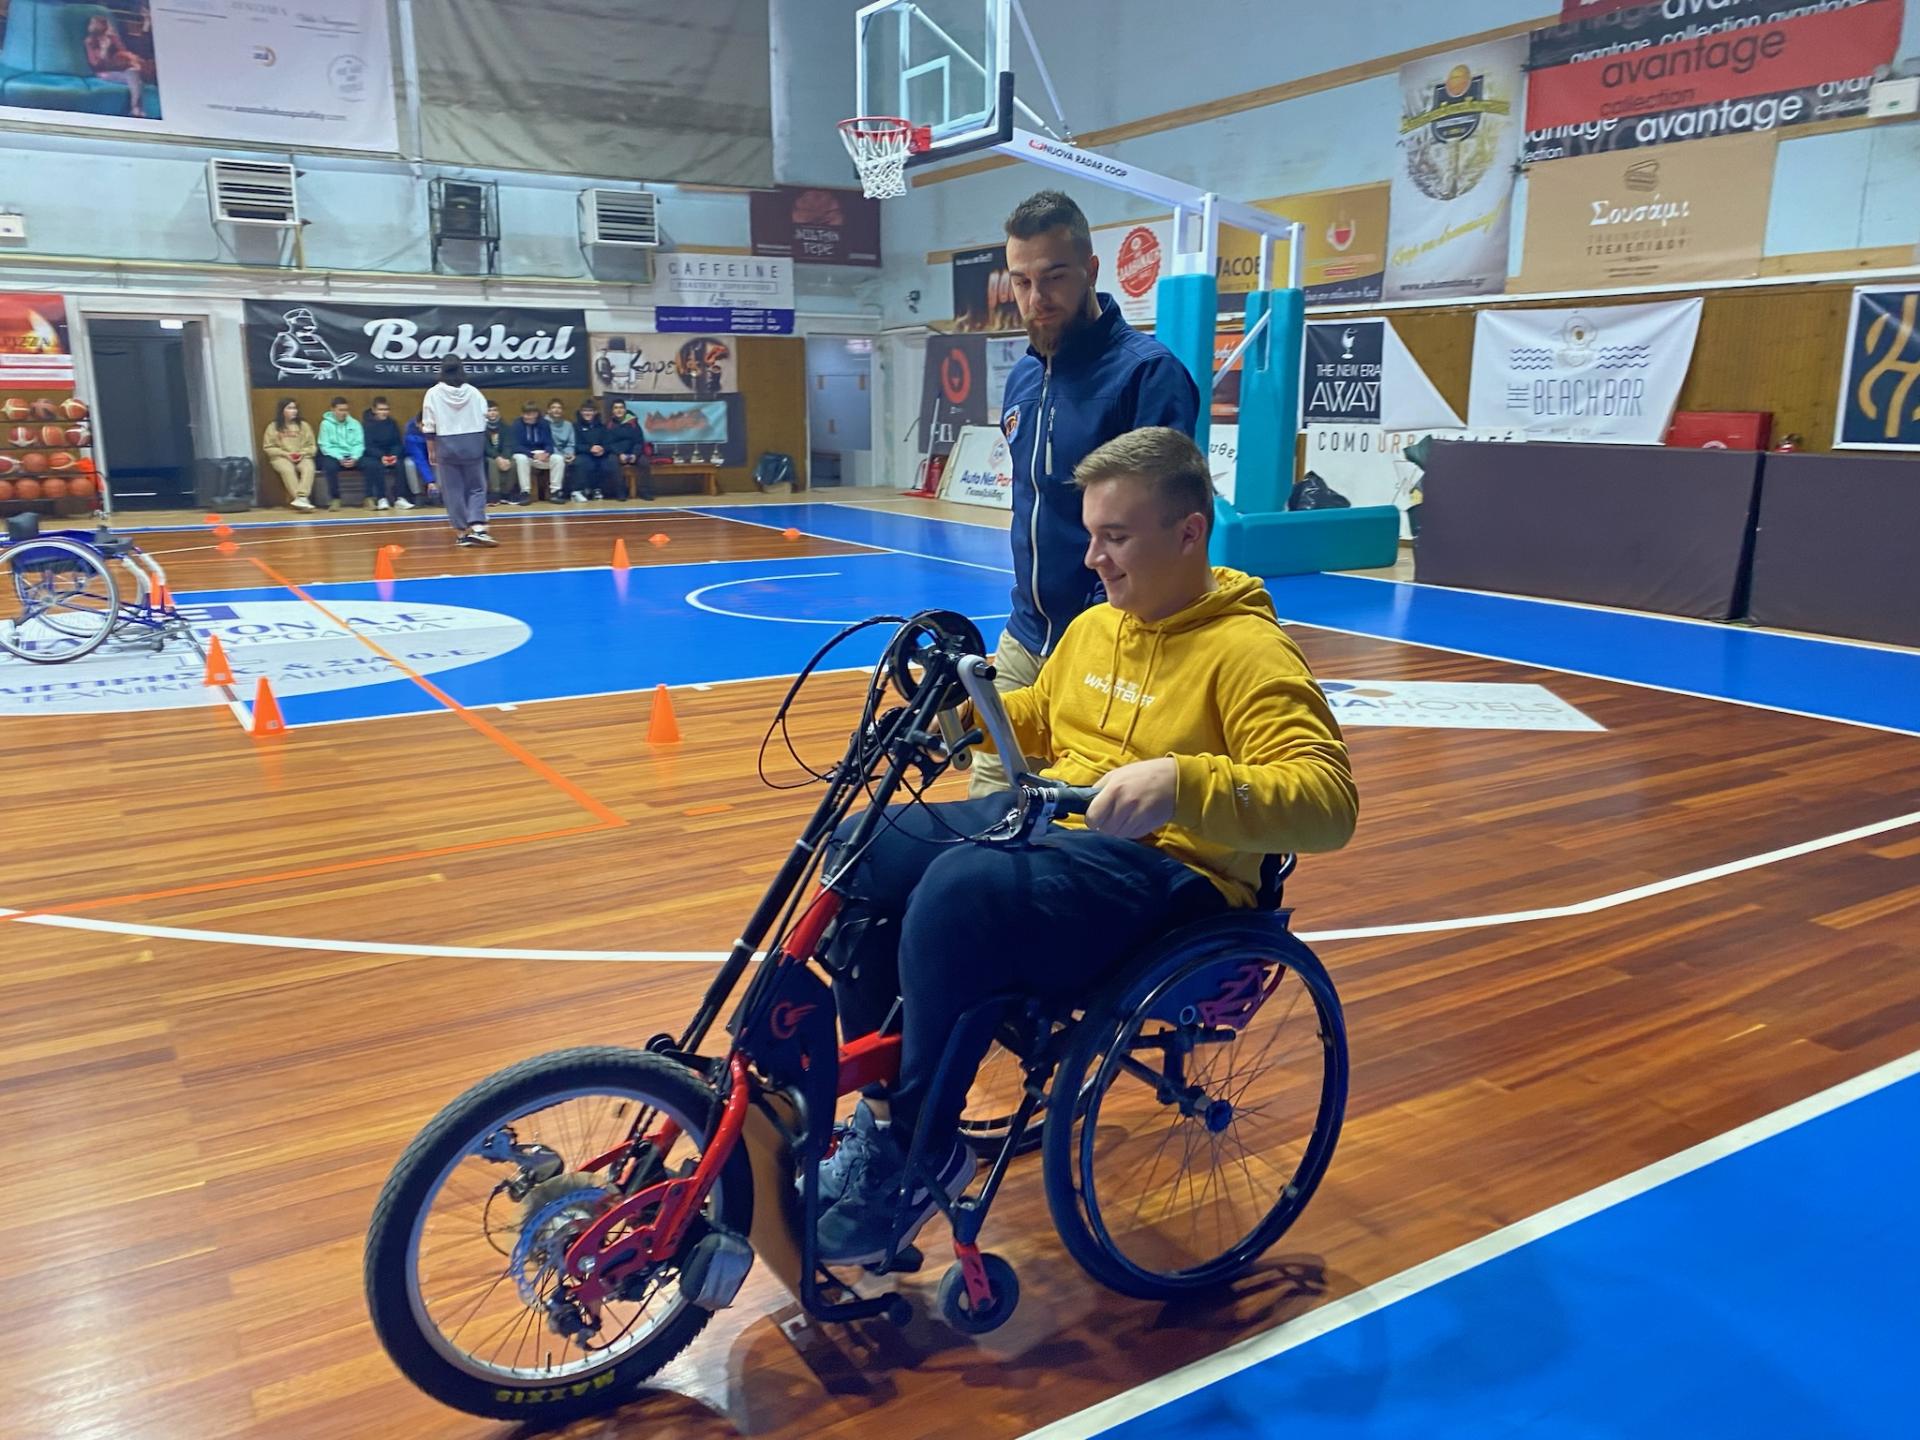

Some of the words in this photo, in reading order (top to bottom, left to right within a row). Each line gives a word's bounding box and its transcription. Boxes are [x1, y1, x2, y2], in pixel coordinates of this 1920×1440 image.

[1601, 29, 1787, 88] avantage
[1635, 94, 1804, 143] avantage
[1043, 144, 1074, 162] NUOVA
[1075, 154, 1104, 170] RADAR
[1104, 164, 1128, 178] COOP
[668, 261, 779, 279] CAFFEINE
[511, 364, 569, 374] COFFEE
[1316, 363, 1336, 377] THE
[1336, 363, 1359, 377] NEW
[1360, 363, 1381, 377] ERA
[1308, 381, 1381, 412] AWAY
[1533, 379, 1600, 416] BEACH
[1603, 378, 1645, 416] BAR
[1318, 431, 1369, 453] COMO
